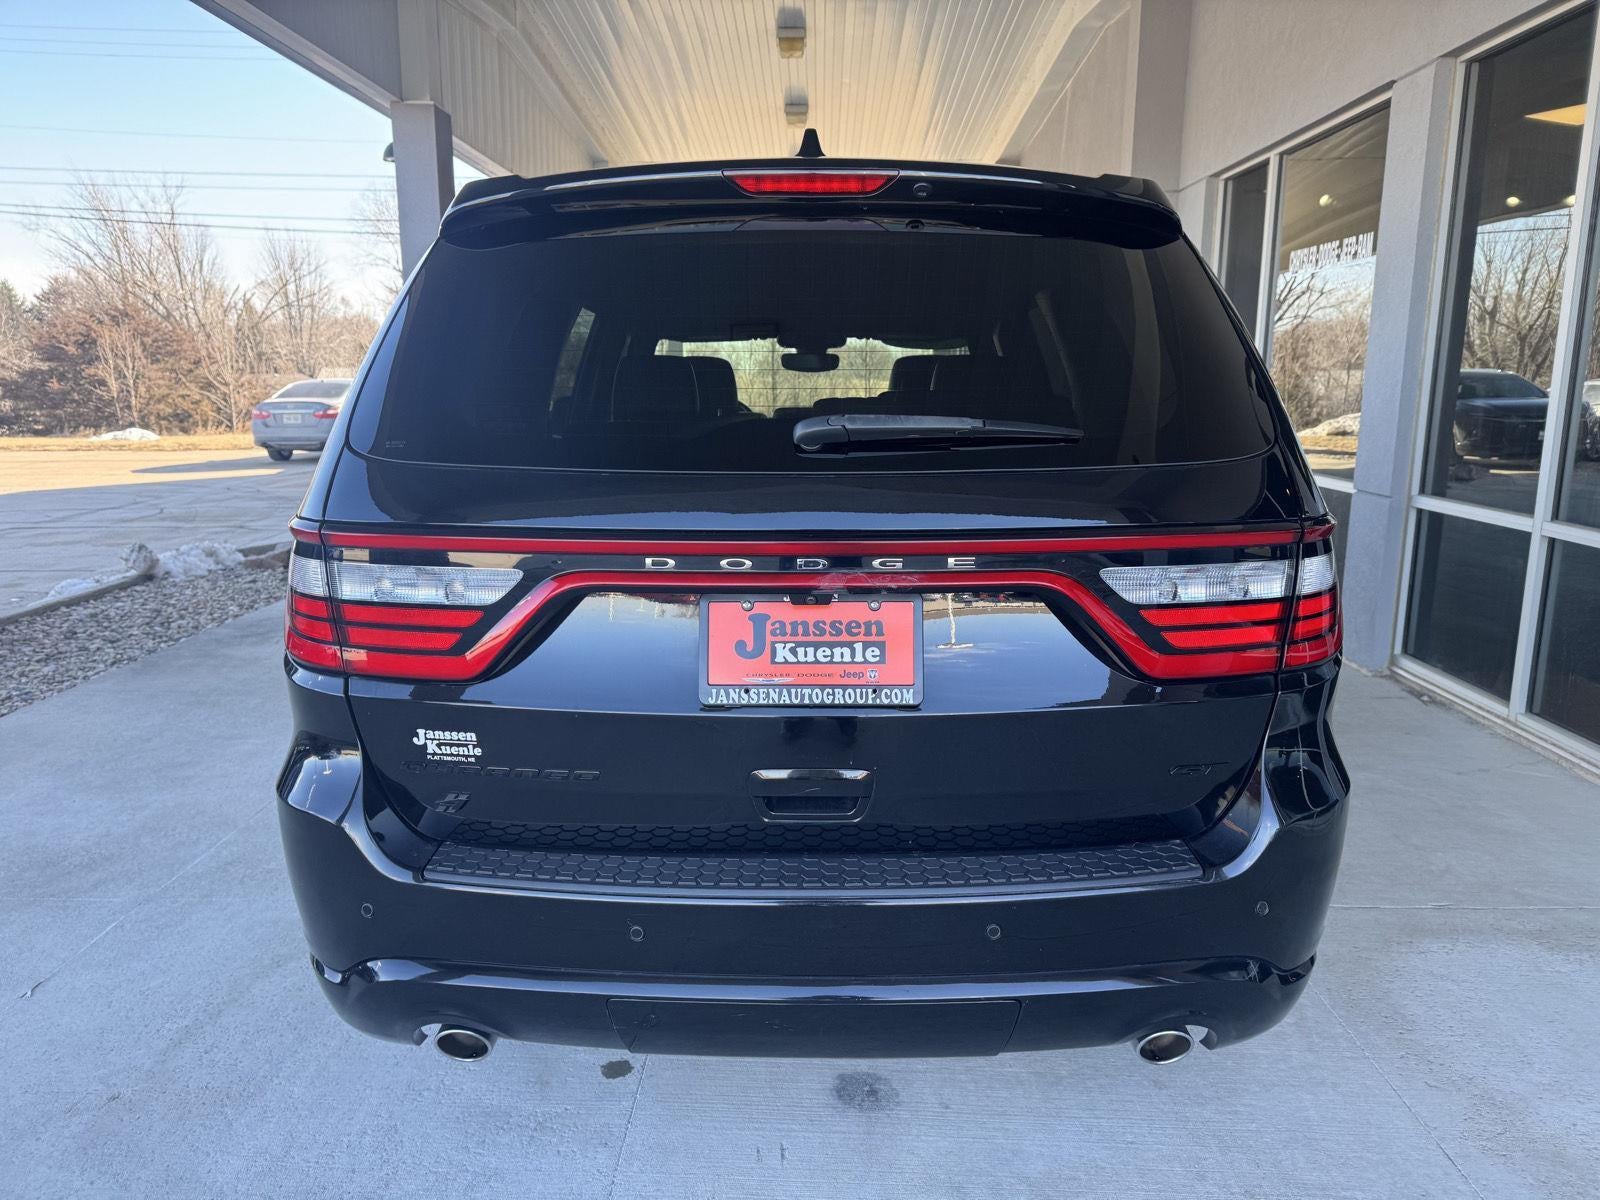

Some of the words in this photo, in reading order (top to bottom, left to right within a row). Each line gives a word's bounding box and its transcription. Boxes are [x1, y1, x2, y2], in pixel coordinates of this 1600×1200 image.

[645, 556, 976, 570] DODGE
[734, 612, 885, 660] Janssen
[774, 642, 880, 663] Kuenle
[839, 669, 864, 680] Jeep
[708, 688, 914, 704] JANSSENAUTOGROUP.COM
[412, 728, 477, 745] Janssen
[425, 740, 482, 756] Kuenle
